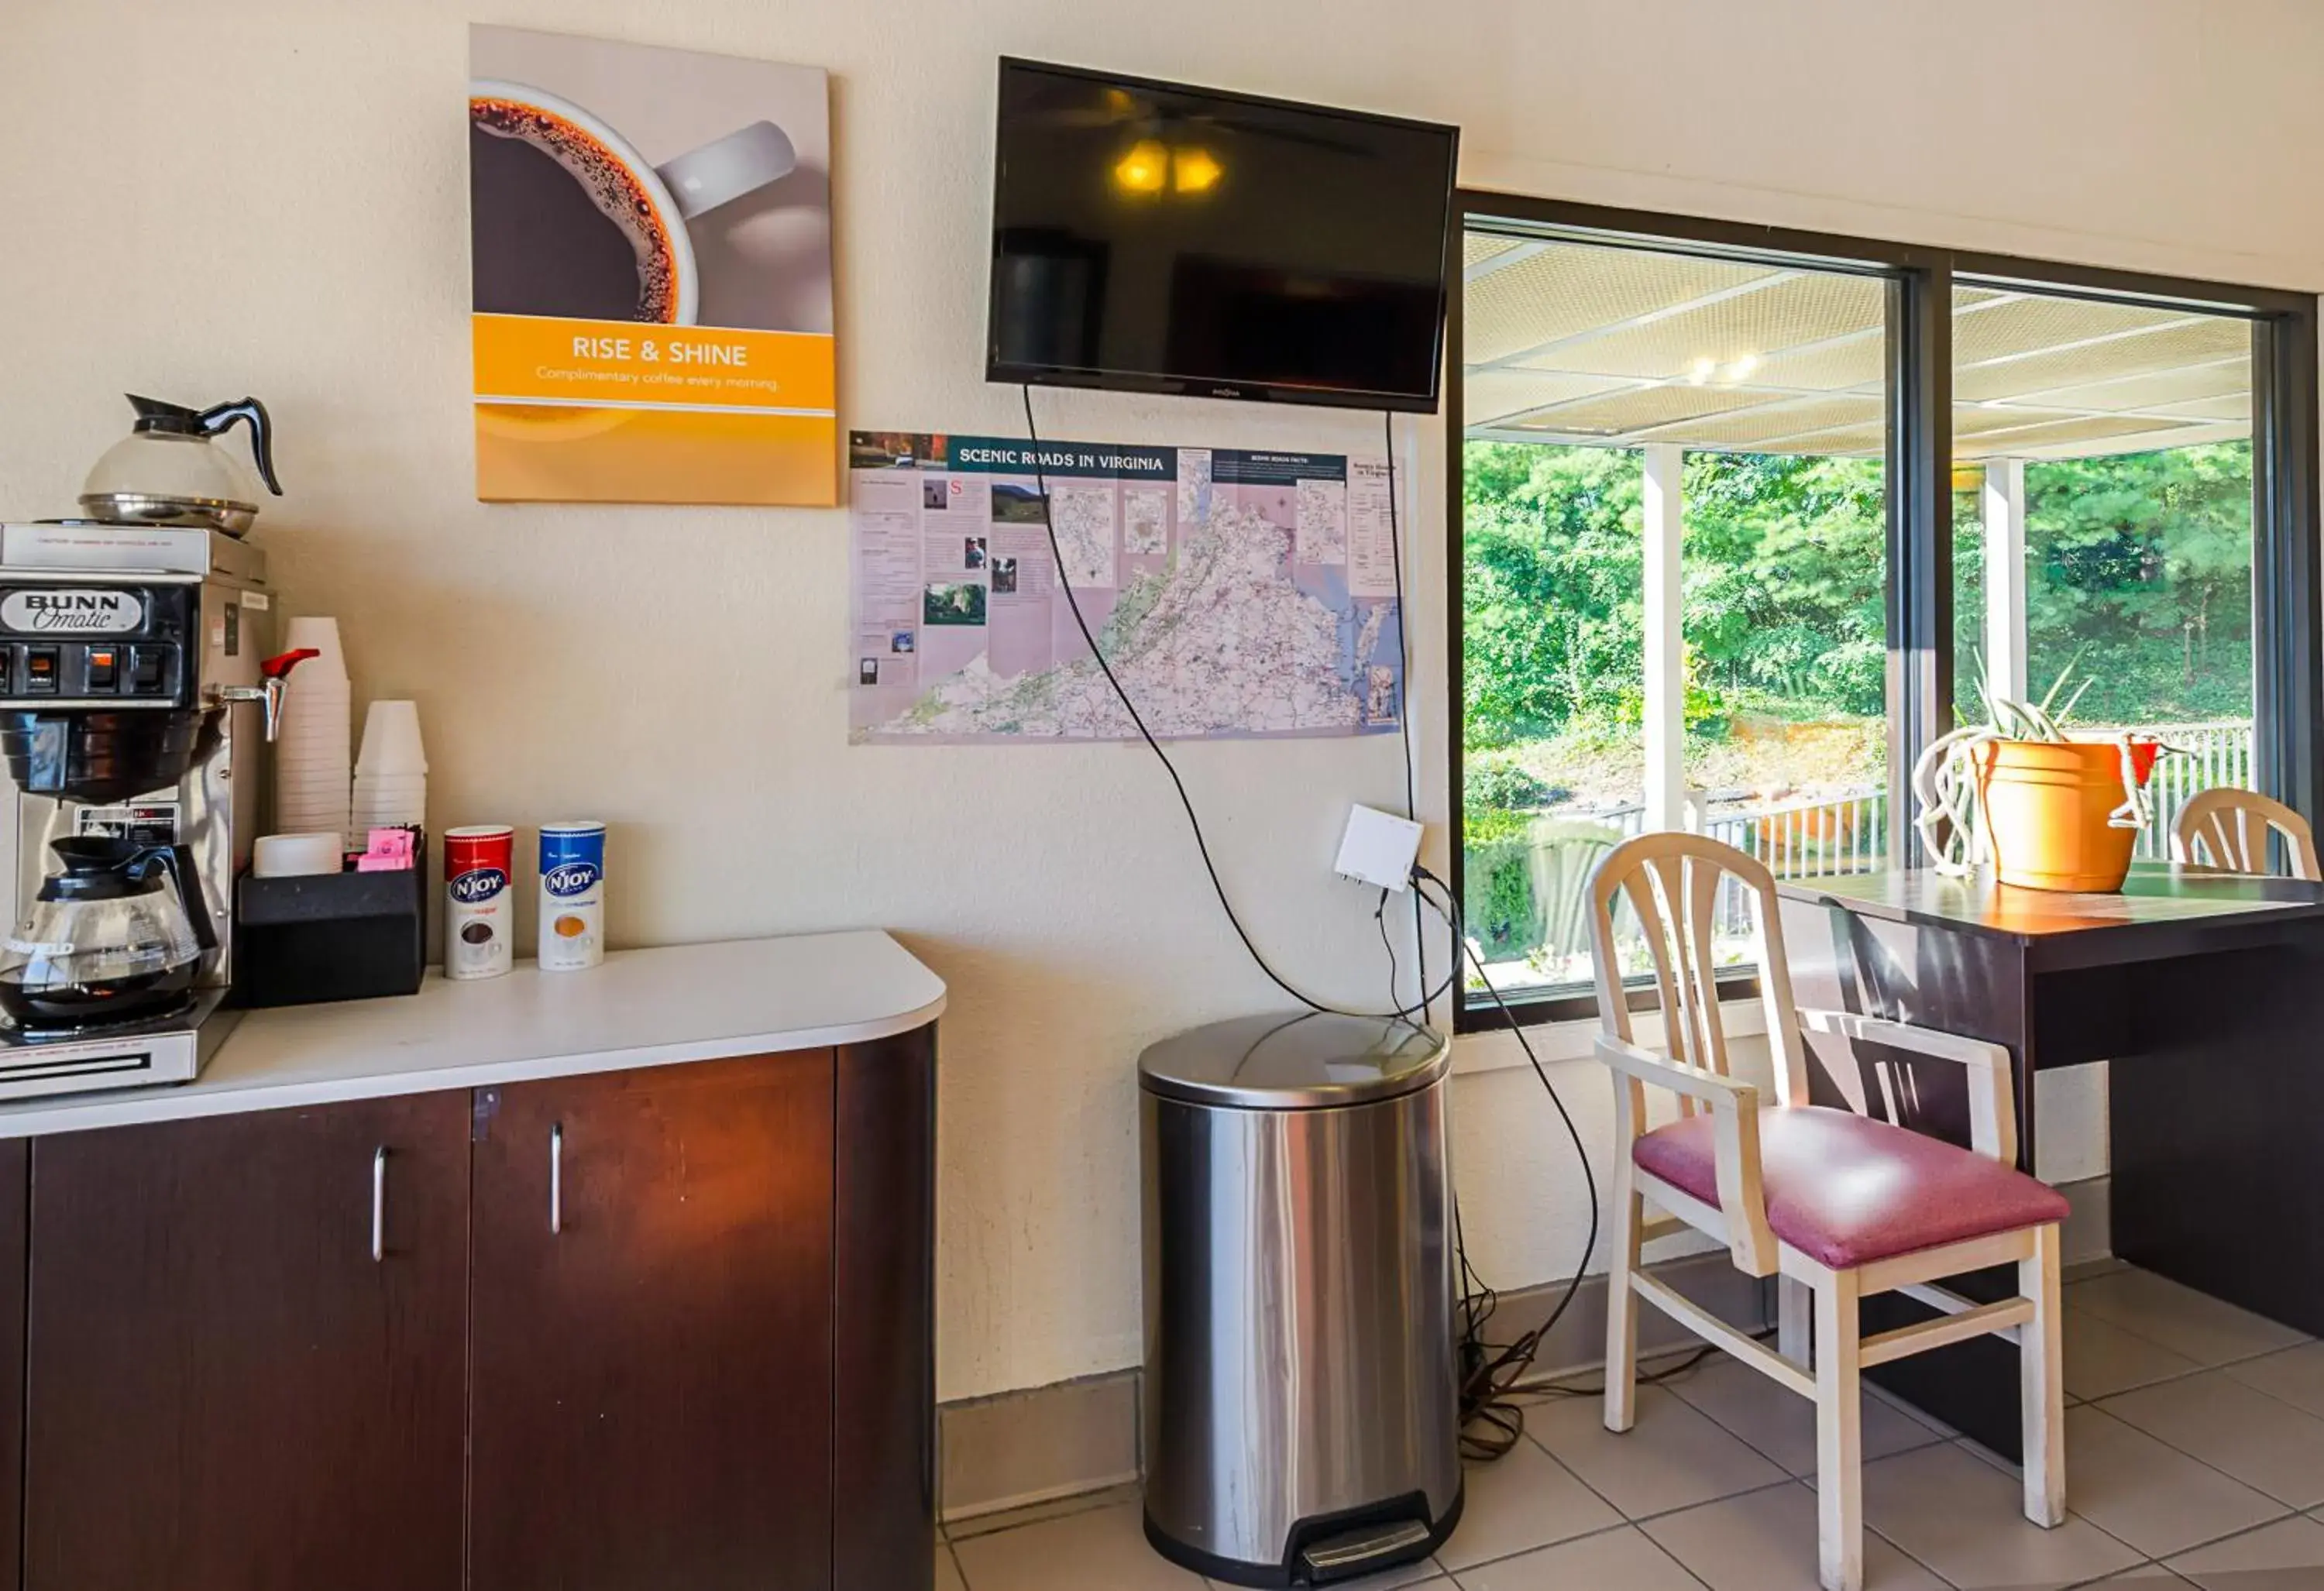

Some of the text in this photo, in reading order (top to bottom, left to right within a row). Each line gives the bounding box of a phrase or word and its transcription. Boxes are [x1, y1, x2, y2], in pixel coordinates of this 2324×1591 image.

[572, 336, 748, 366] RISE & SHINE
[535, 366, 638, 384] Complimentary
[642, 373, 683, 384] coffee
[686, 376, 721, 389] every
[960, 448, 1164, 471] SCENIC ROADS IN VIRGINIA
[26, 595, 119, 610] BUNN
[33, 606, 112, 629] Omatic
